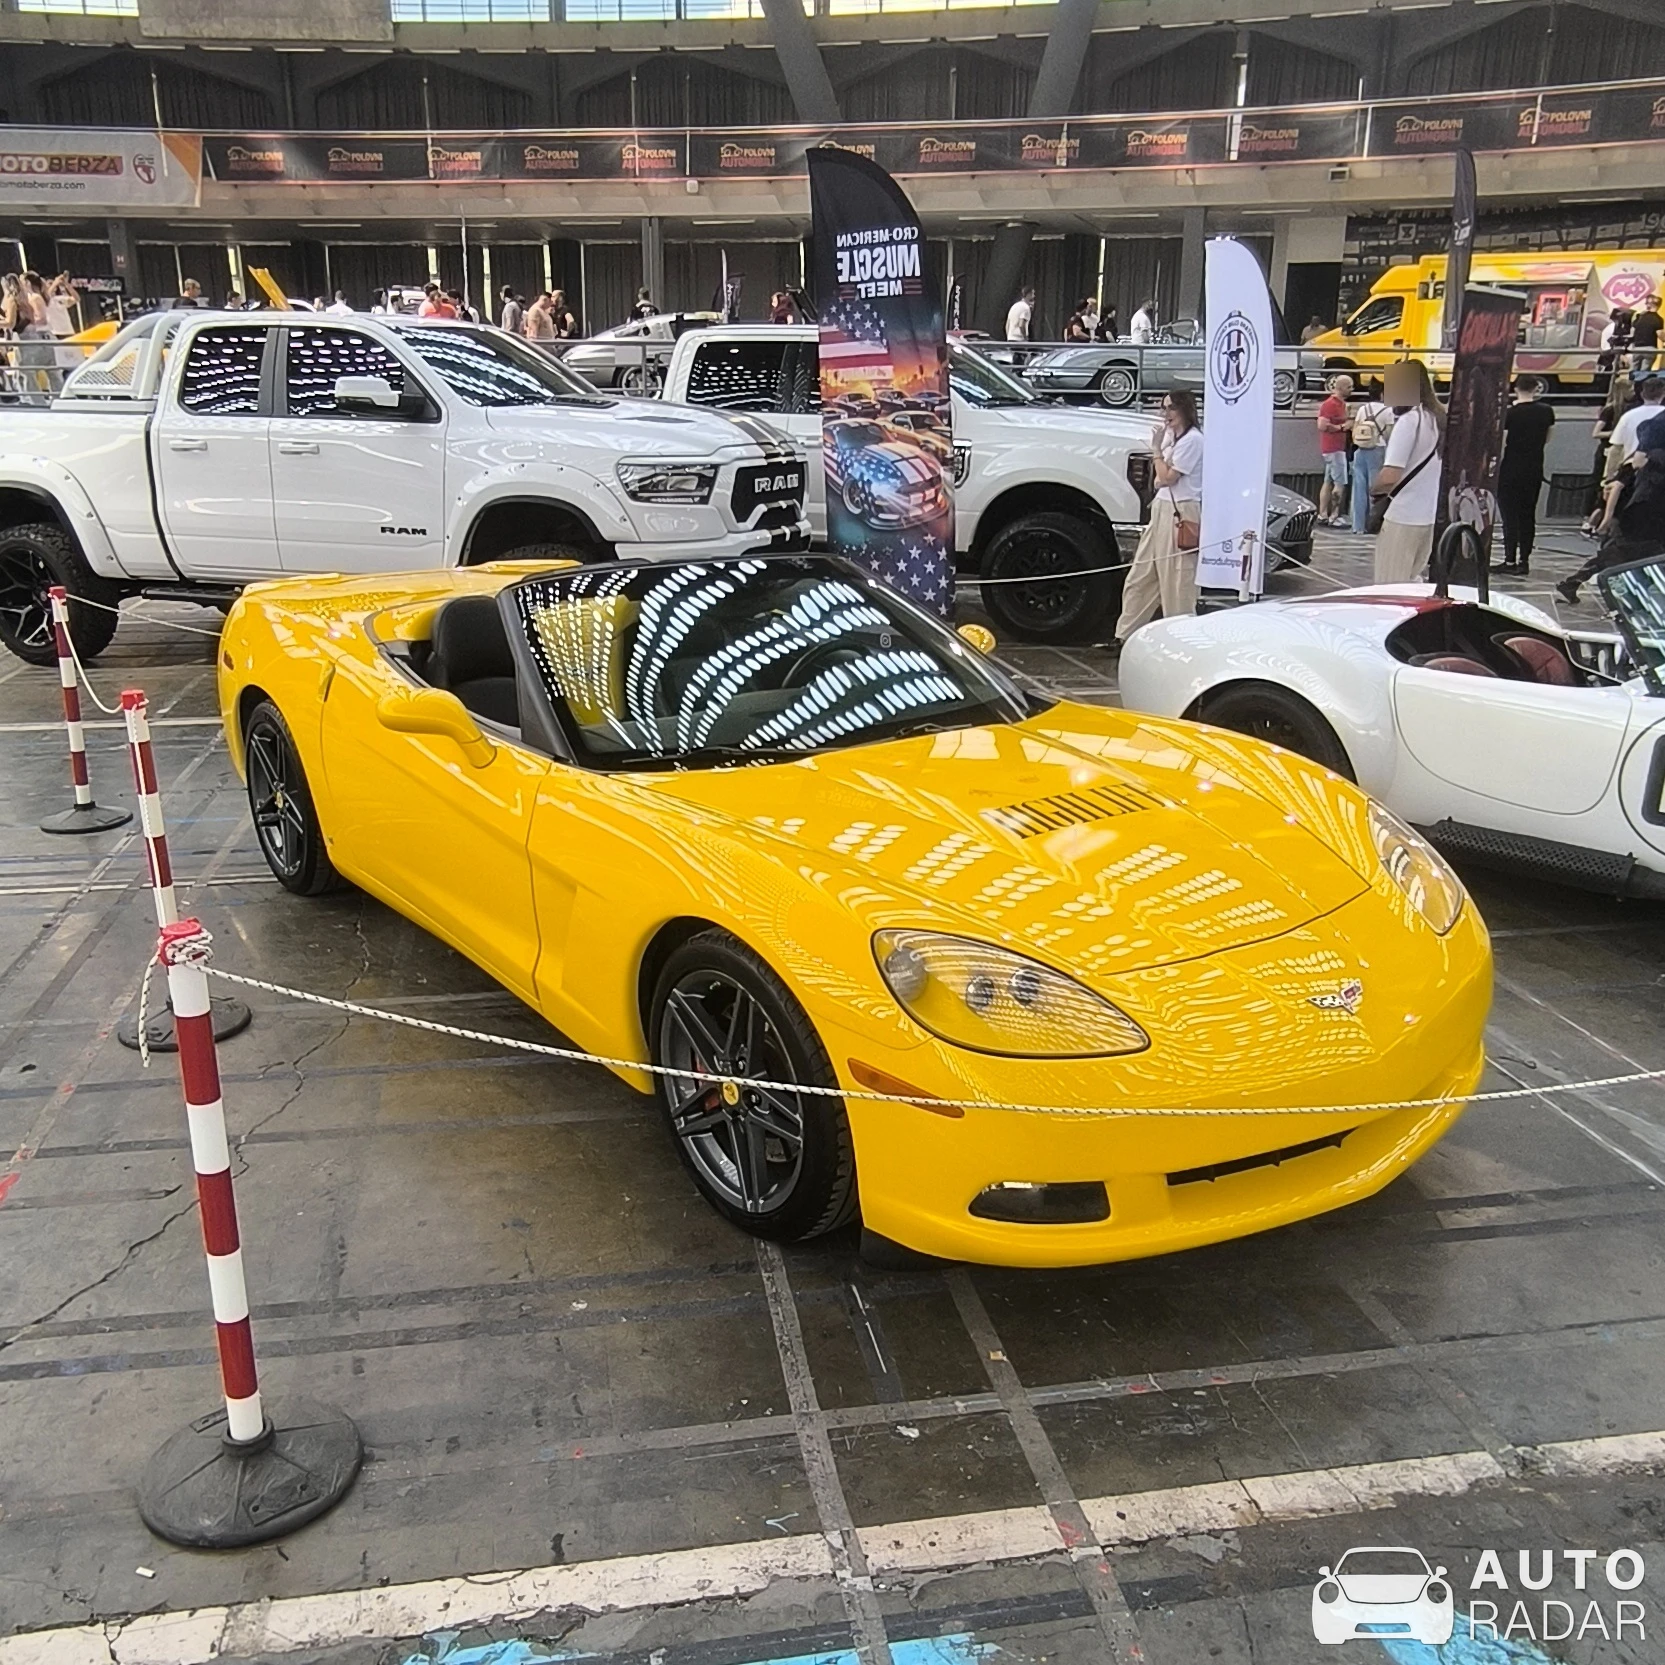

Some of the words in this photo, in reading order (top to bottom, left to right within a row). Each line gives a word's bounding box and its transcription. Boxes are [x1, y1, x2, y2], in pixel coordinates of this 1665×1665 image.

[1551, 110, 1592, 122] POLOVNI
[1424, 119, 1463, 129] POLOVNI
[755, 473, 799, 493] RAM
[380, 526, 427, 536] RAM
